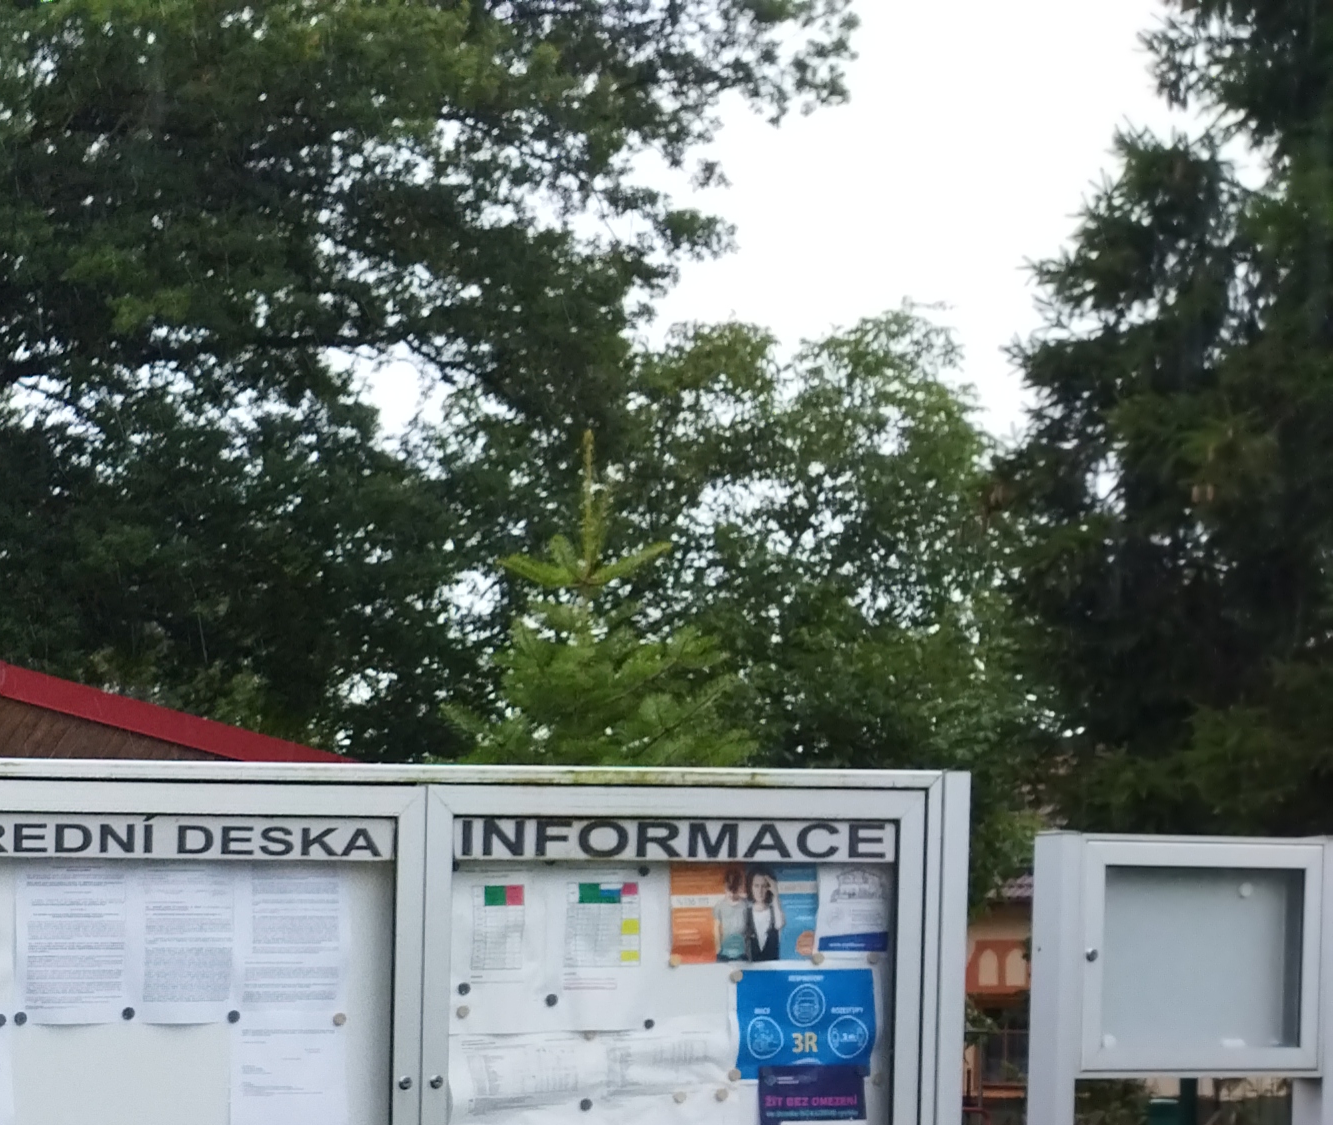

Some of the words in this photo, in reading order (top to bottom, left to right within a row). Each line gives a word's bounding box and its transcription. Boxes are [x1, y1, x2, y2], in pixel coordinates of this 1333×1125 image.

[177, 825, 382, 857] DESKA
[460, 818, 887, 860] INFORMACE
[792, 1031, 818, 1053] 3R
[786, 1096, 809, 1107] BEZ
